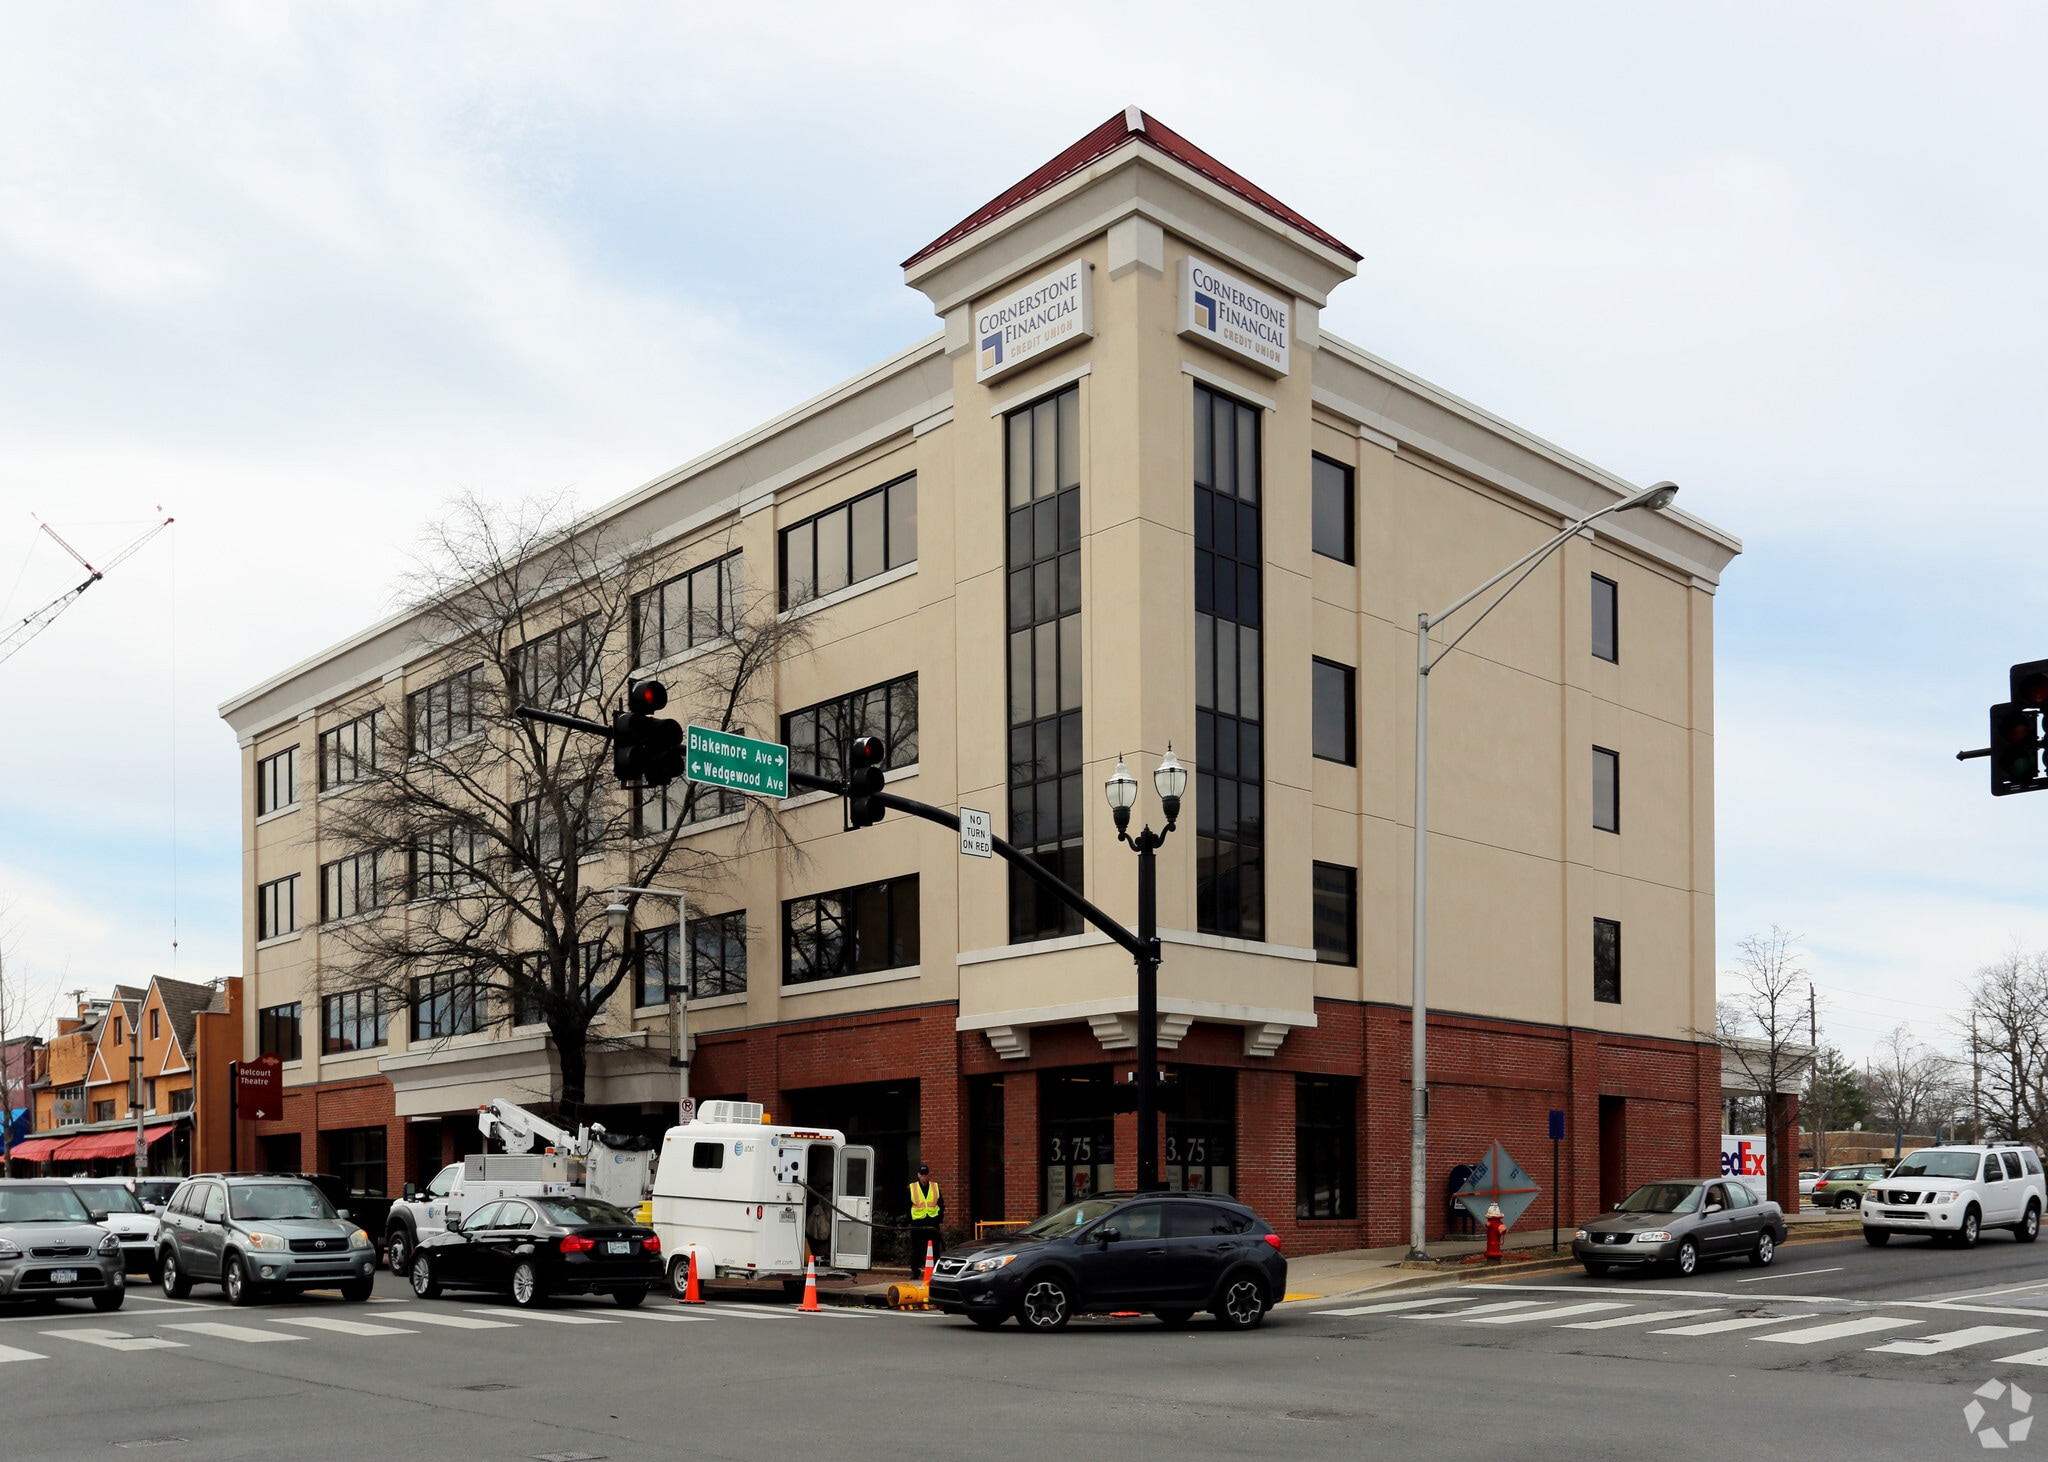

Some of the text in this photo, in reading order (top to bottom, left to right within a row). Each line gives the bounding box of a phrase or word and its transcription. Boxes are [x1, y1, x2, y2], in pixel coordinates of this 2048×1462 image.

[980, 273, 1077, 334] CORNERSTONE
[1193, 268, 1285, 328] CORNERSTONE
[1006, 296, 1077, 344] FINANCIAL
[1219, 301, 1285, 349] FINANCIAL
[1011, 319, 1073, 358] CREDIT UNION
[1224, 328, 1280, 363] CREDIT UNION
[690, 733, 772, 765] Blakemore Ave
[704, 762, 784, 791] Wedgewood Ave
[967, 827, 985, 838] TURN
[970, 815, 981, 825] NO
[963, 840, 989, 852] ON RED
[240, 1068, 271, 1077] Belcourt
[241, 1077, 269, 1085] Theatre
[1721, 1141, 1765, 1176] edEx
